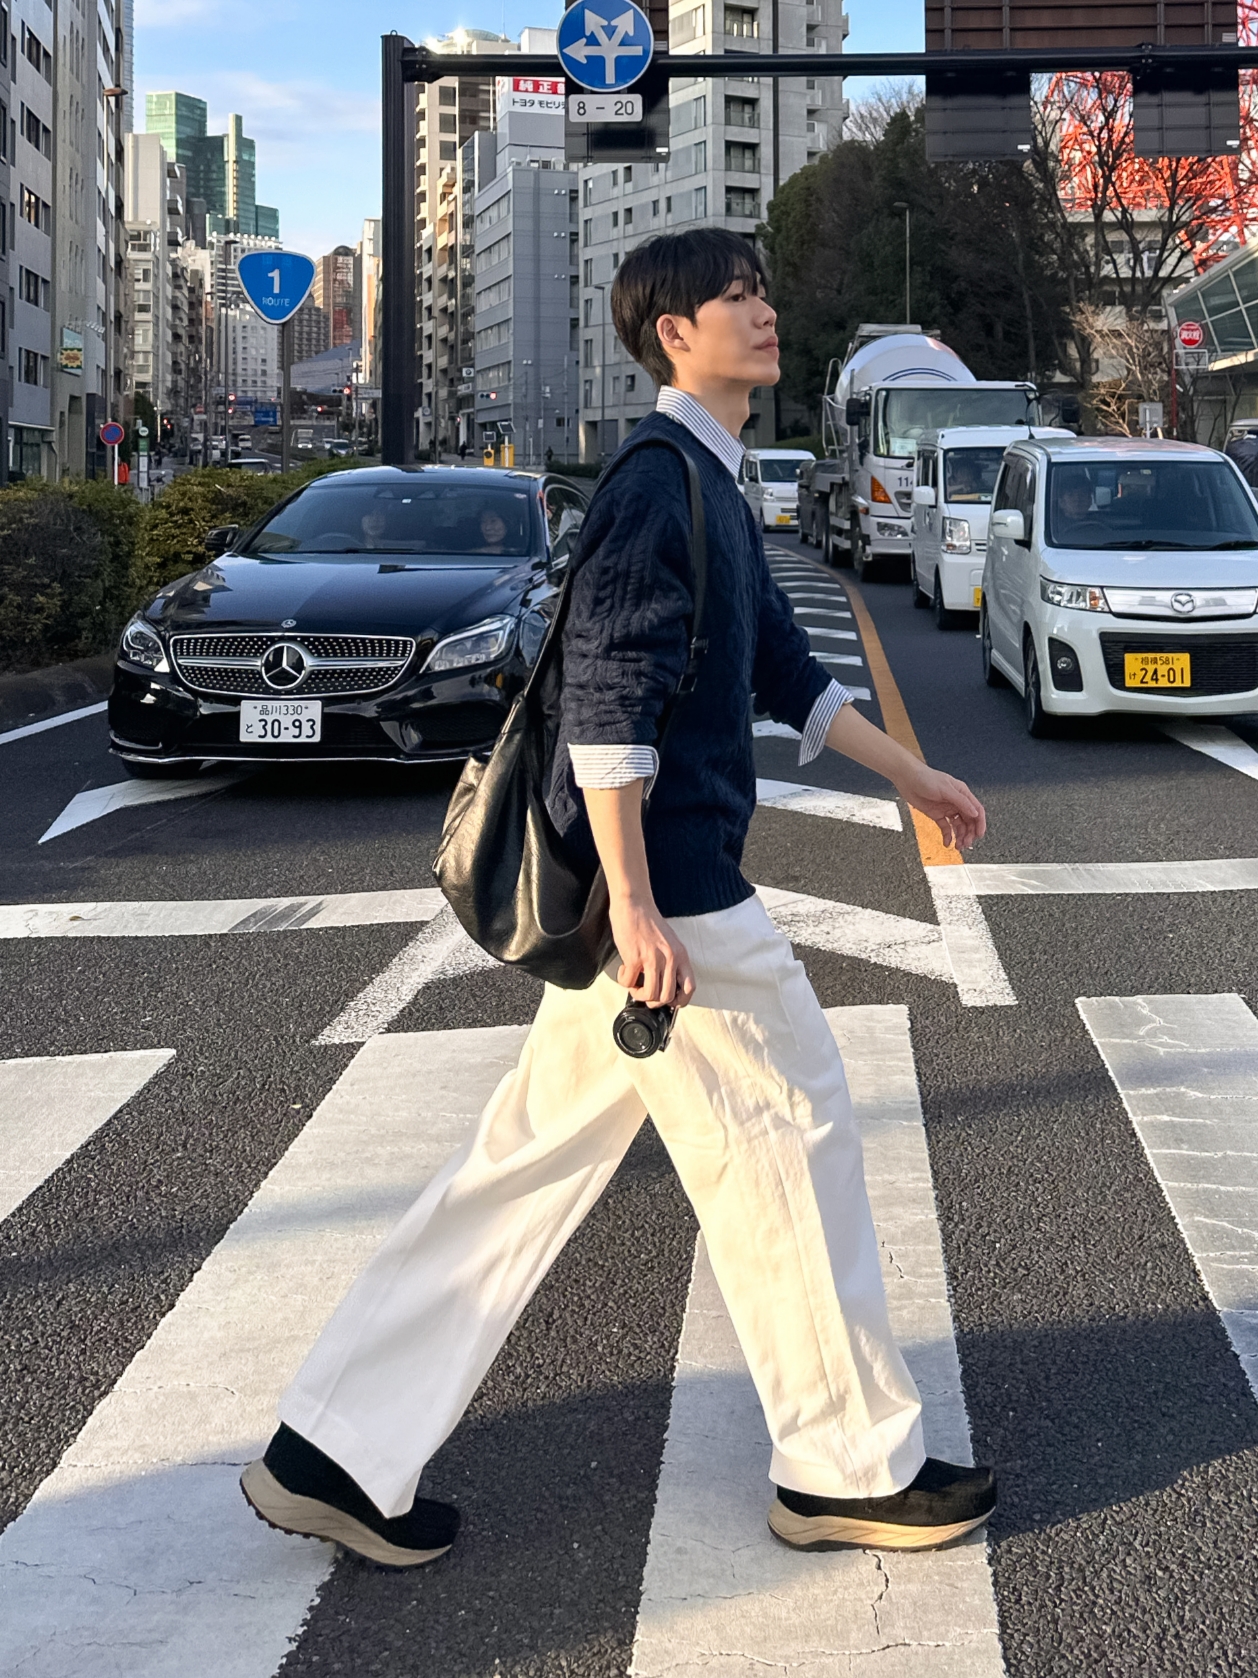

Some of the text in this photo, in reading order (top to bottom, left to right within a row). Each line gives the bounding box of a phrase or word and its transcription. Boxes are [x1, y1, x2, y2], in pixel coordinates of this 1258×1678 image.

[512, 98, 535, 107] トヨタ
[577, 101, 587, 116] 8
[614, 101, 634, 116] 20
[267, 268, 280, 294] 1
[262, 296, 290, 307] ROUTE
[1140, 667, 1184, 684] 24-01
[245, 718, 316, 739] と 30-93
